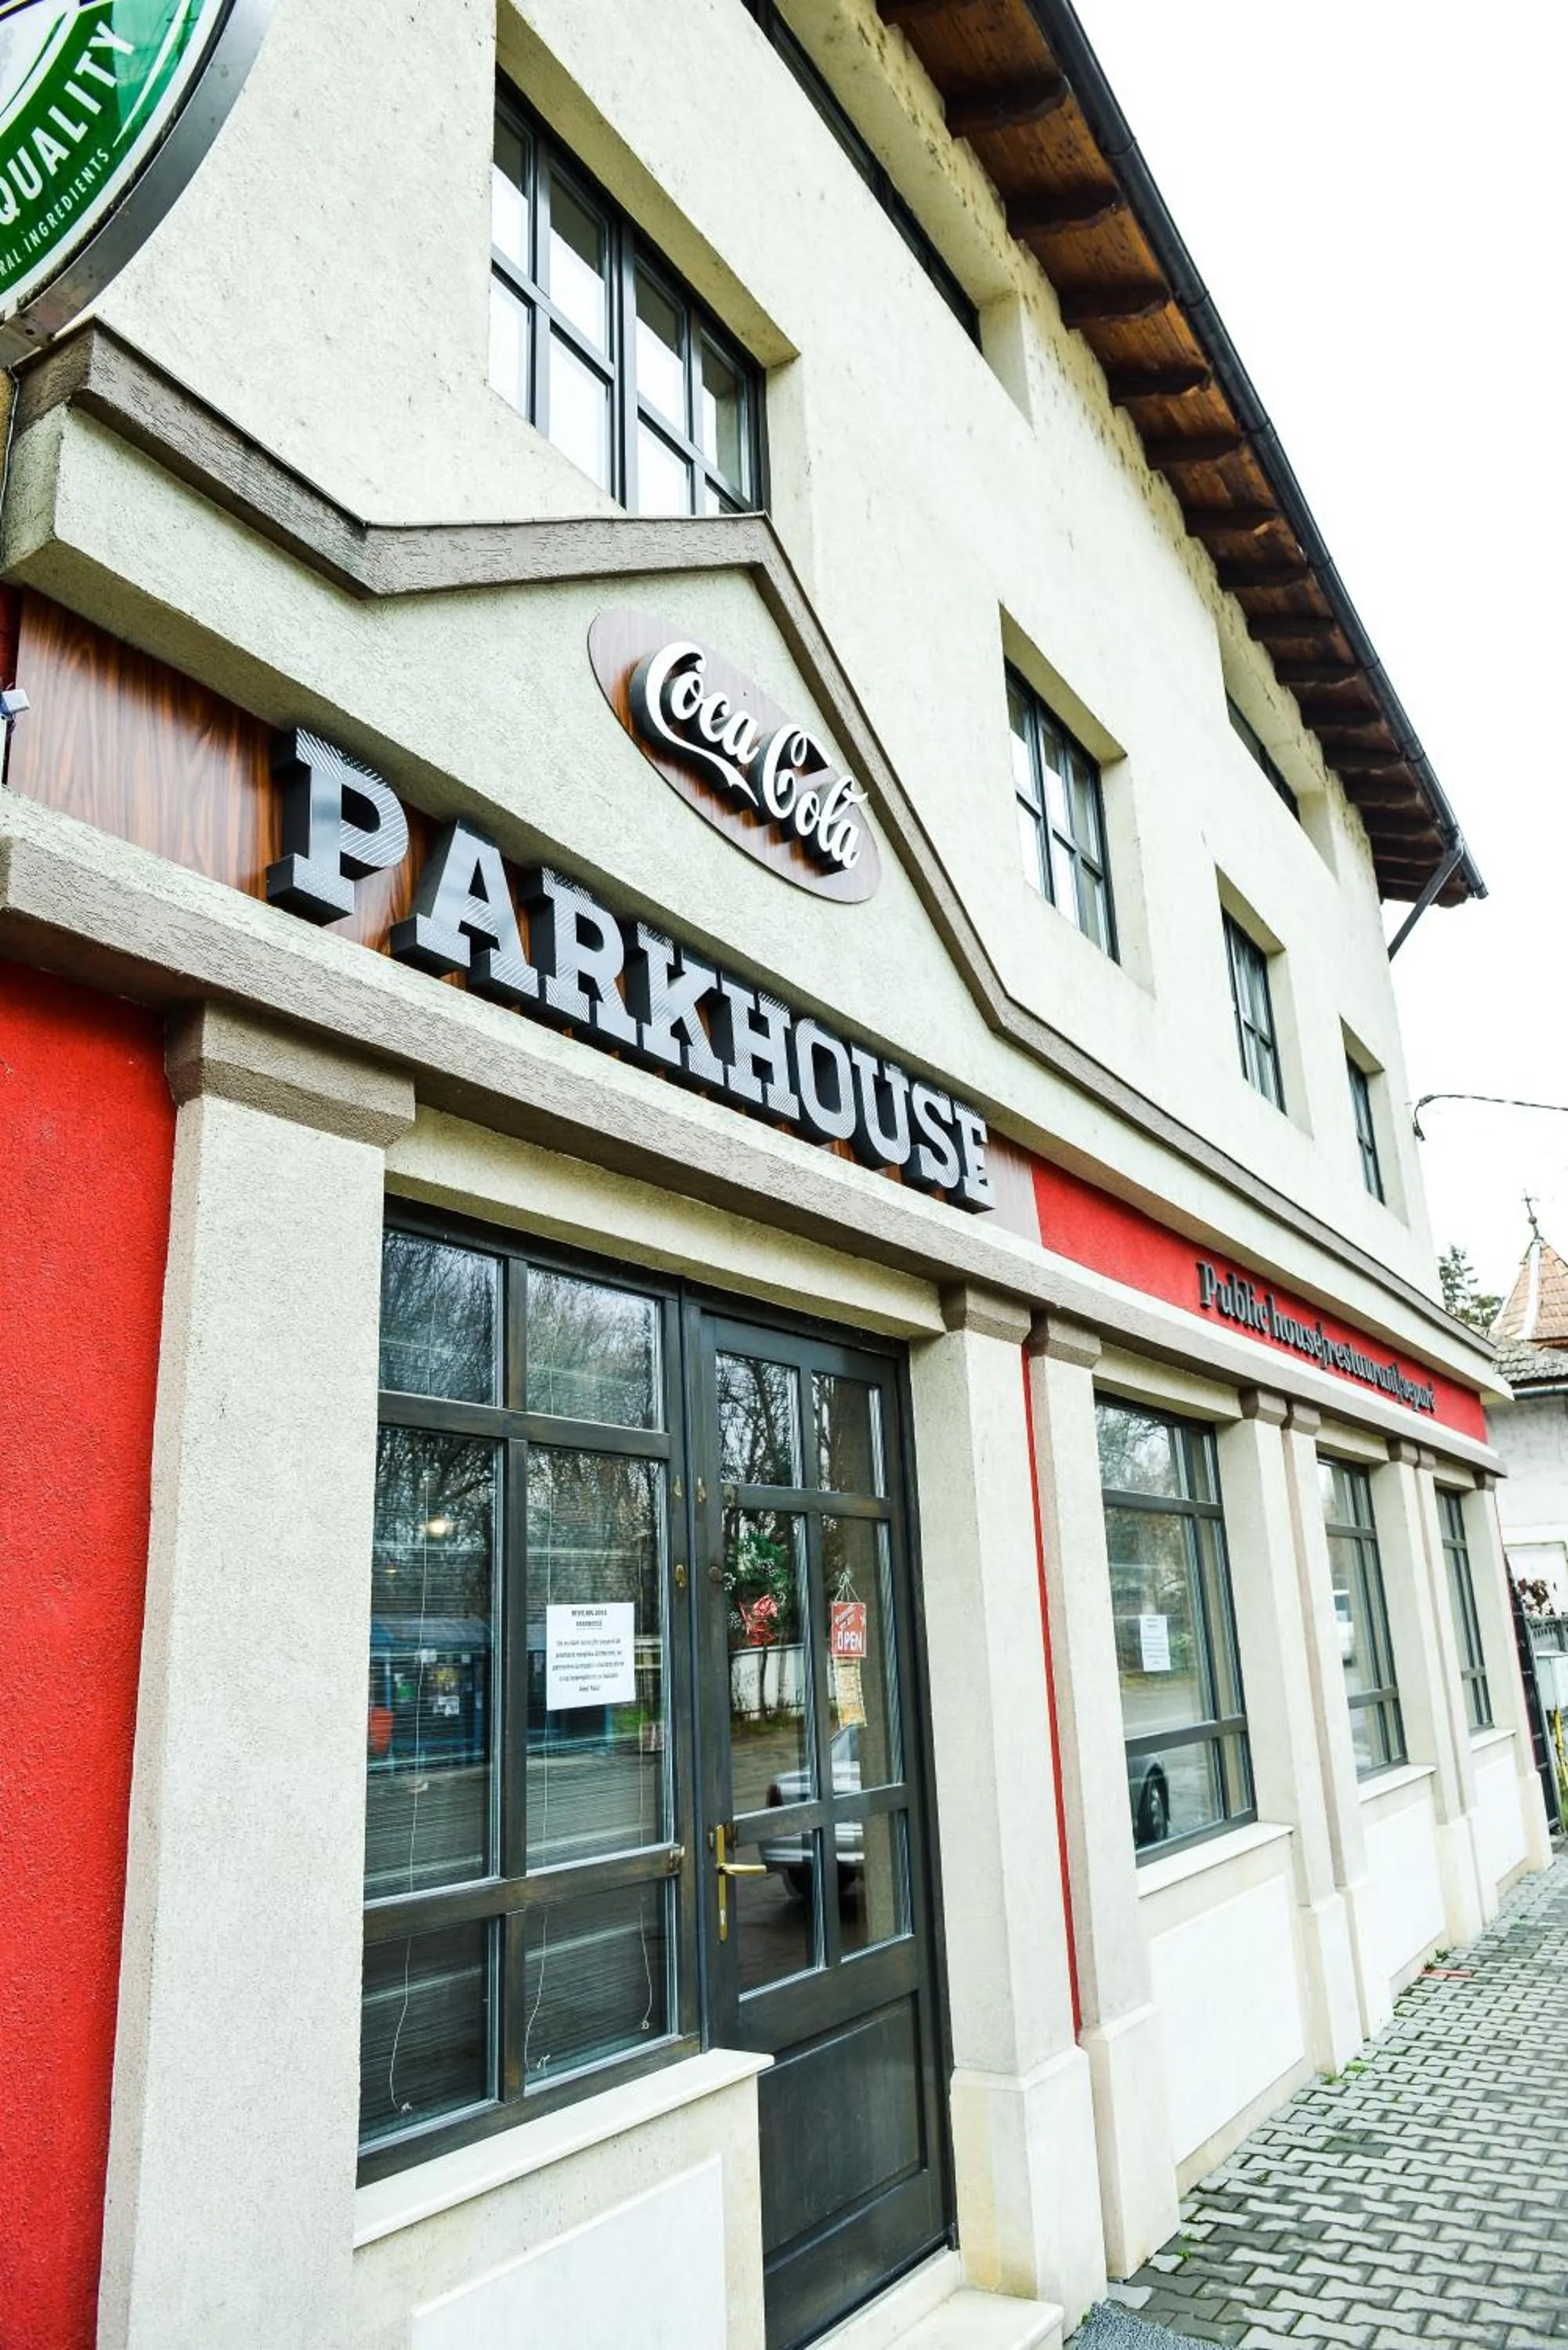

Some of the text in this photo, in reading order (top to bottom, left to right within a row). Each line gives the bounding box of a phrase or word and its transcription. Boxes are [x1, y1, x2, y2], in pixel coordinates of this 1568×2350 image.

[23, 147, 109, 253] INGREDIENTS
[641, 640, 869, 870] Coca Cola
[271, 728, 996, 1213] PARKHOUSE
[1197, 1261, 1269, 1333] Public
[837, 1630, 862, 1651] OPEN
